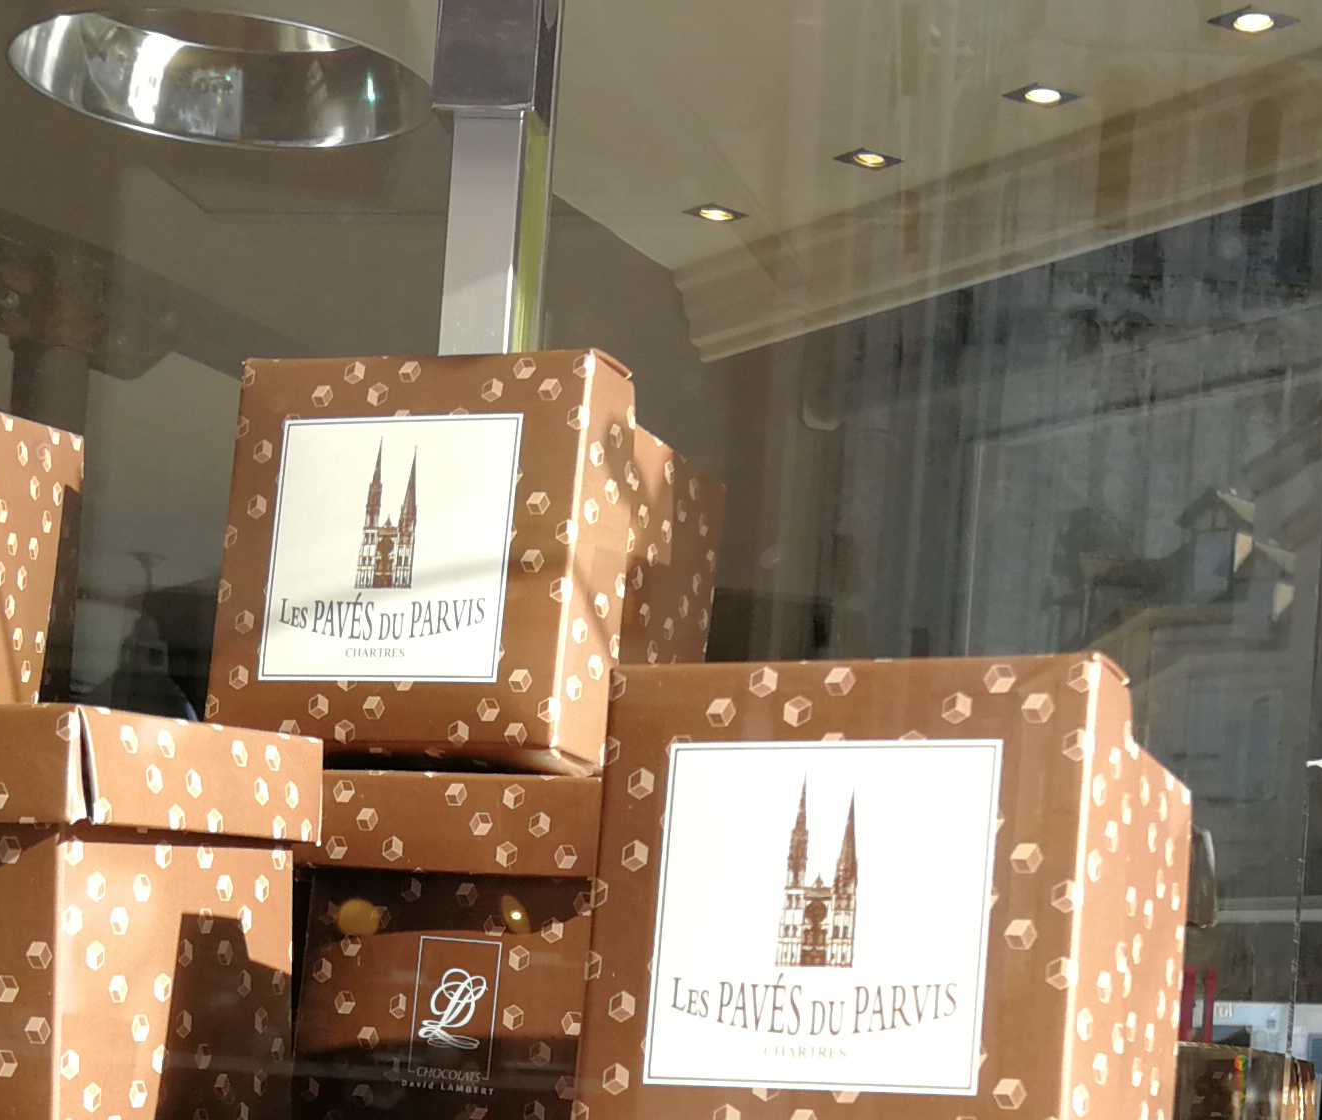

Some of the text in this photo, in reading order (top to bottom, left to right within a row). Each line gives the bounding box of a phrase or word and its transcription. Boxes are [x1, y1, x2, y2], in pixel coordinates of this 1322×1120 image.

[312, 592, 375, 641] PAVÉS
[409, 597, 486, 639] PARVIS
[345, 647, 405, 658] CHARTRES
[716, 973, 802, 1036] PAVÉS
[852, 983, 957, 1034] PARVIS
[416, 1066, 481, 1082] CHOCOLATS
[401, 1079, 494, 1096] David LAMBERT
